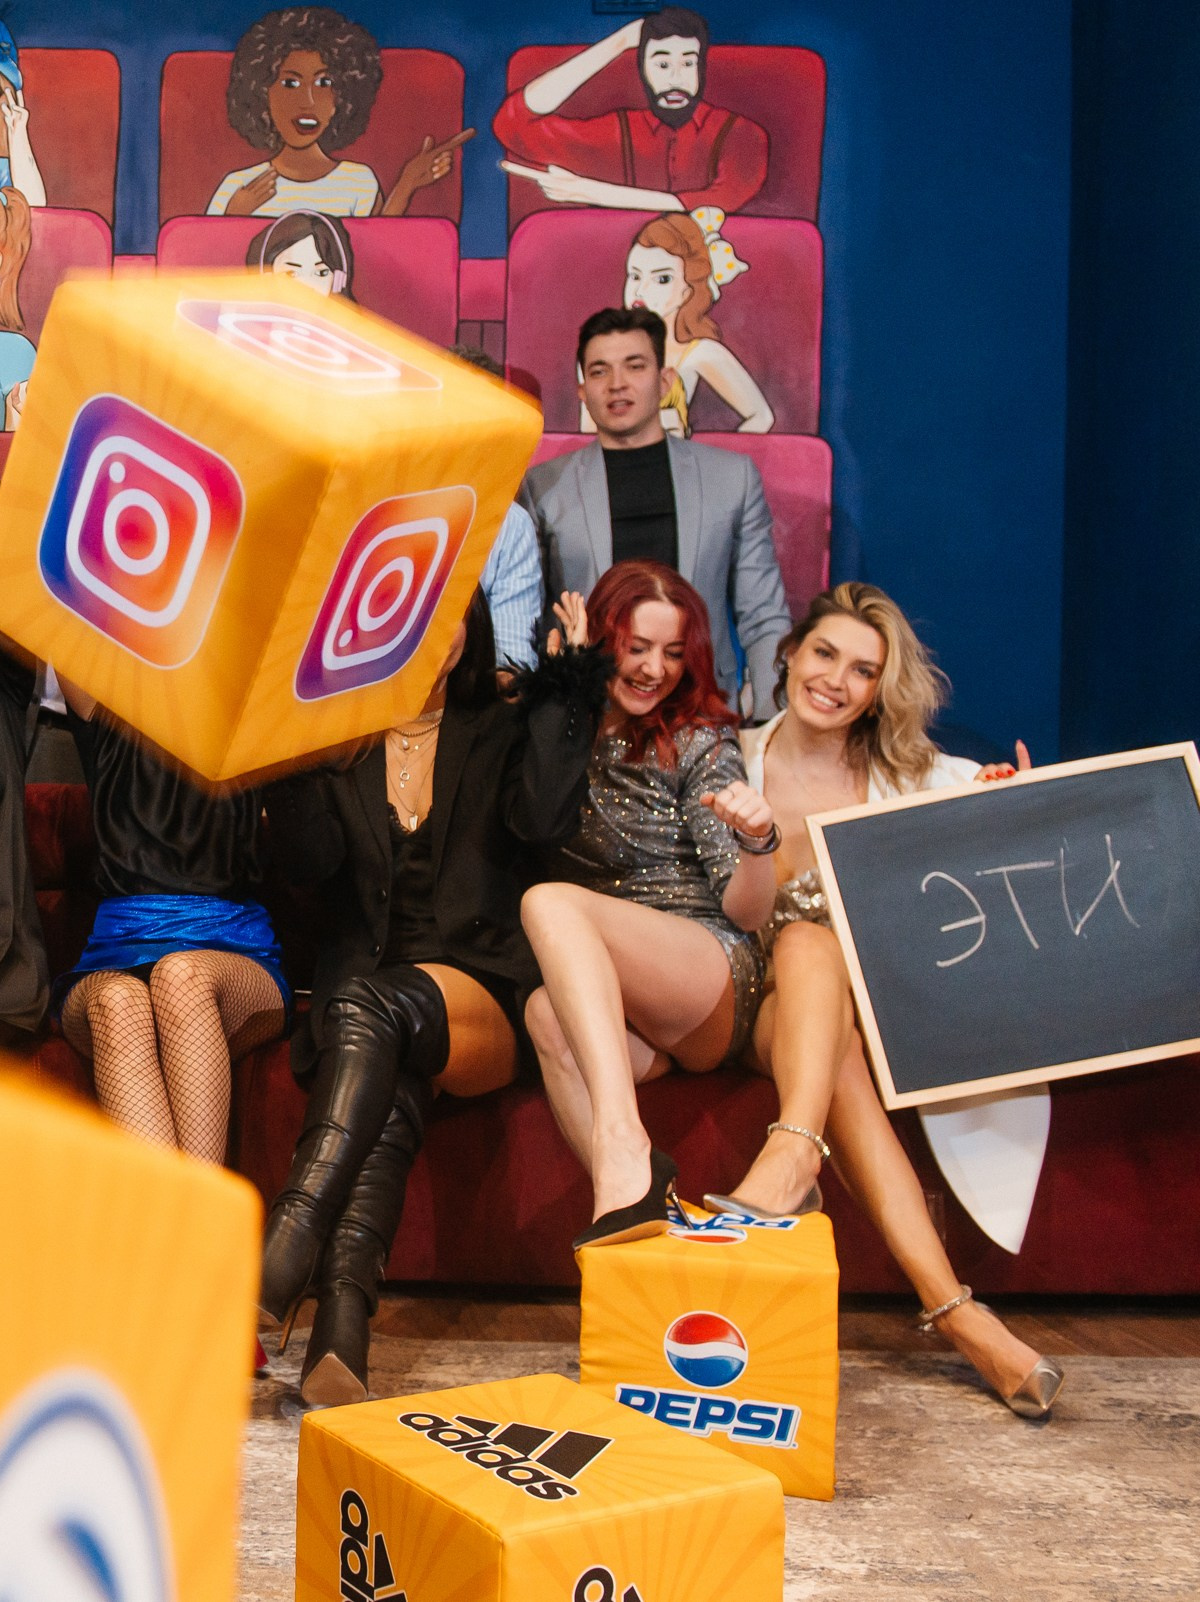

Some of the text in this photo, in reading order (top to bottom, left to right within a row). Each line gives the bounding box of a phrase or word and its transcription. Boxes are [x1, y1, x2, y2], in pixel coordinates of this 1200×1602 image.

[920, 833, 1140, 968] ЭТИ
[398, 1412, 579, 1501] adidas
[617, 1386, 799, 1444] PEPSI
